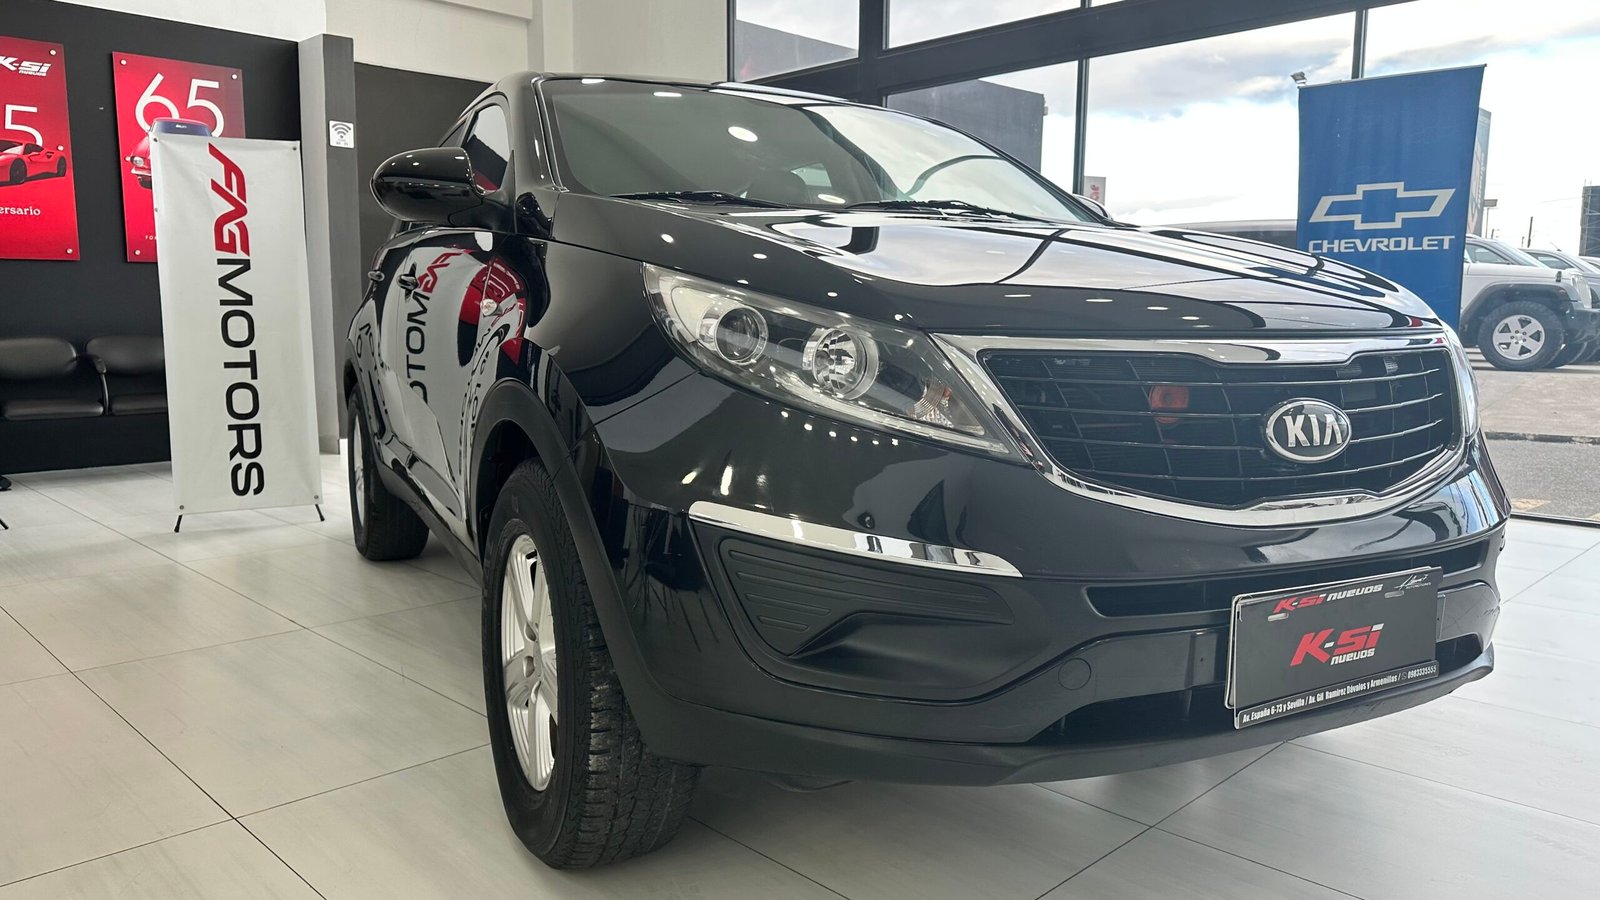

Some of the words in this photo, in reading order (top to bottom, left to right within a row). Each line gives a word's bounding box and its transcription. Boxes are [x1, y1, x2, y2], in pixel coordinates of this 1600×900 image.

[135, 73, 224, 138] 65
[1308, 235, 1456, 254] CHEVROLET
[1283, 414, 1342, 447] KIA
[1273, 594, 1326, 614] K-Si
[1290, 623, 1384, 666] K-Si
[1251, 708, 1271, 720] España
[1287, 698, 1305, 711] Sevilla
